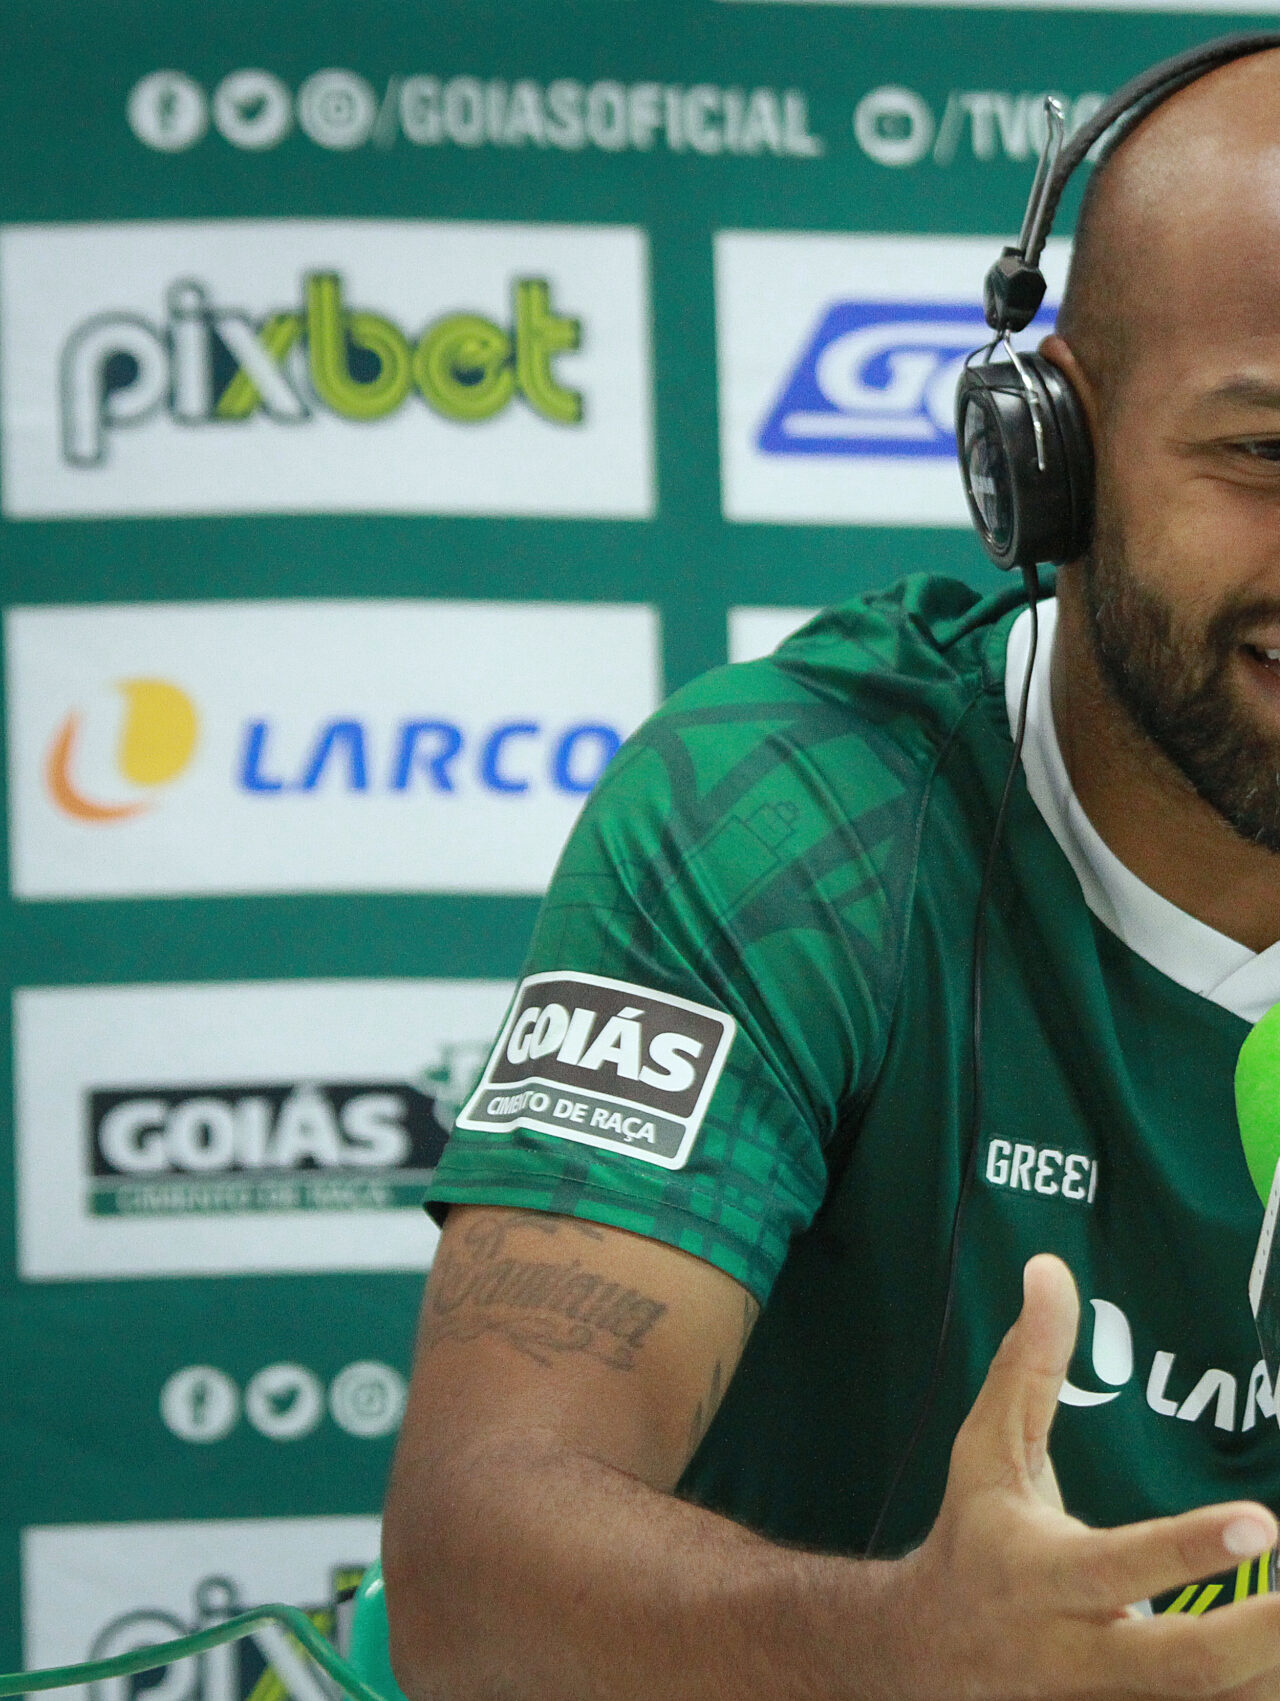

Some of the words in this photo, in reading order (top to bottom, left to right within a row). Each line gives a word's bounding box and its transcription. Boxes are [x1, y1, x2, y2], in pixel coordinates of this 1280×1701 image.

[60, 270, 585, 467] pixbet
[237, 716, 620, 795] LARCO
[506, 1003, 704, 1093] GOIÁS
[487, 1091, 550, 1116] CIMENTO
[553, 1098, 588, 1124] DE
[590, 1108, 657, 1143] RAÇA
